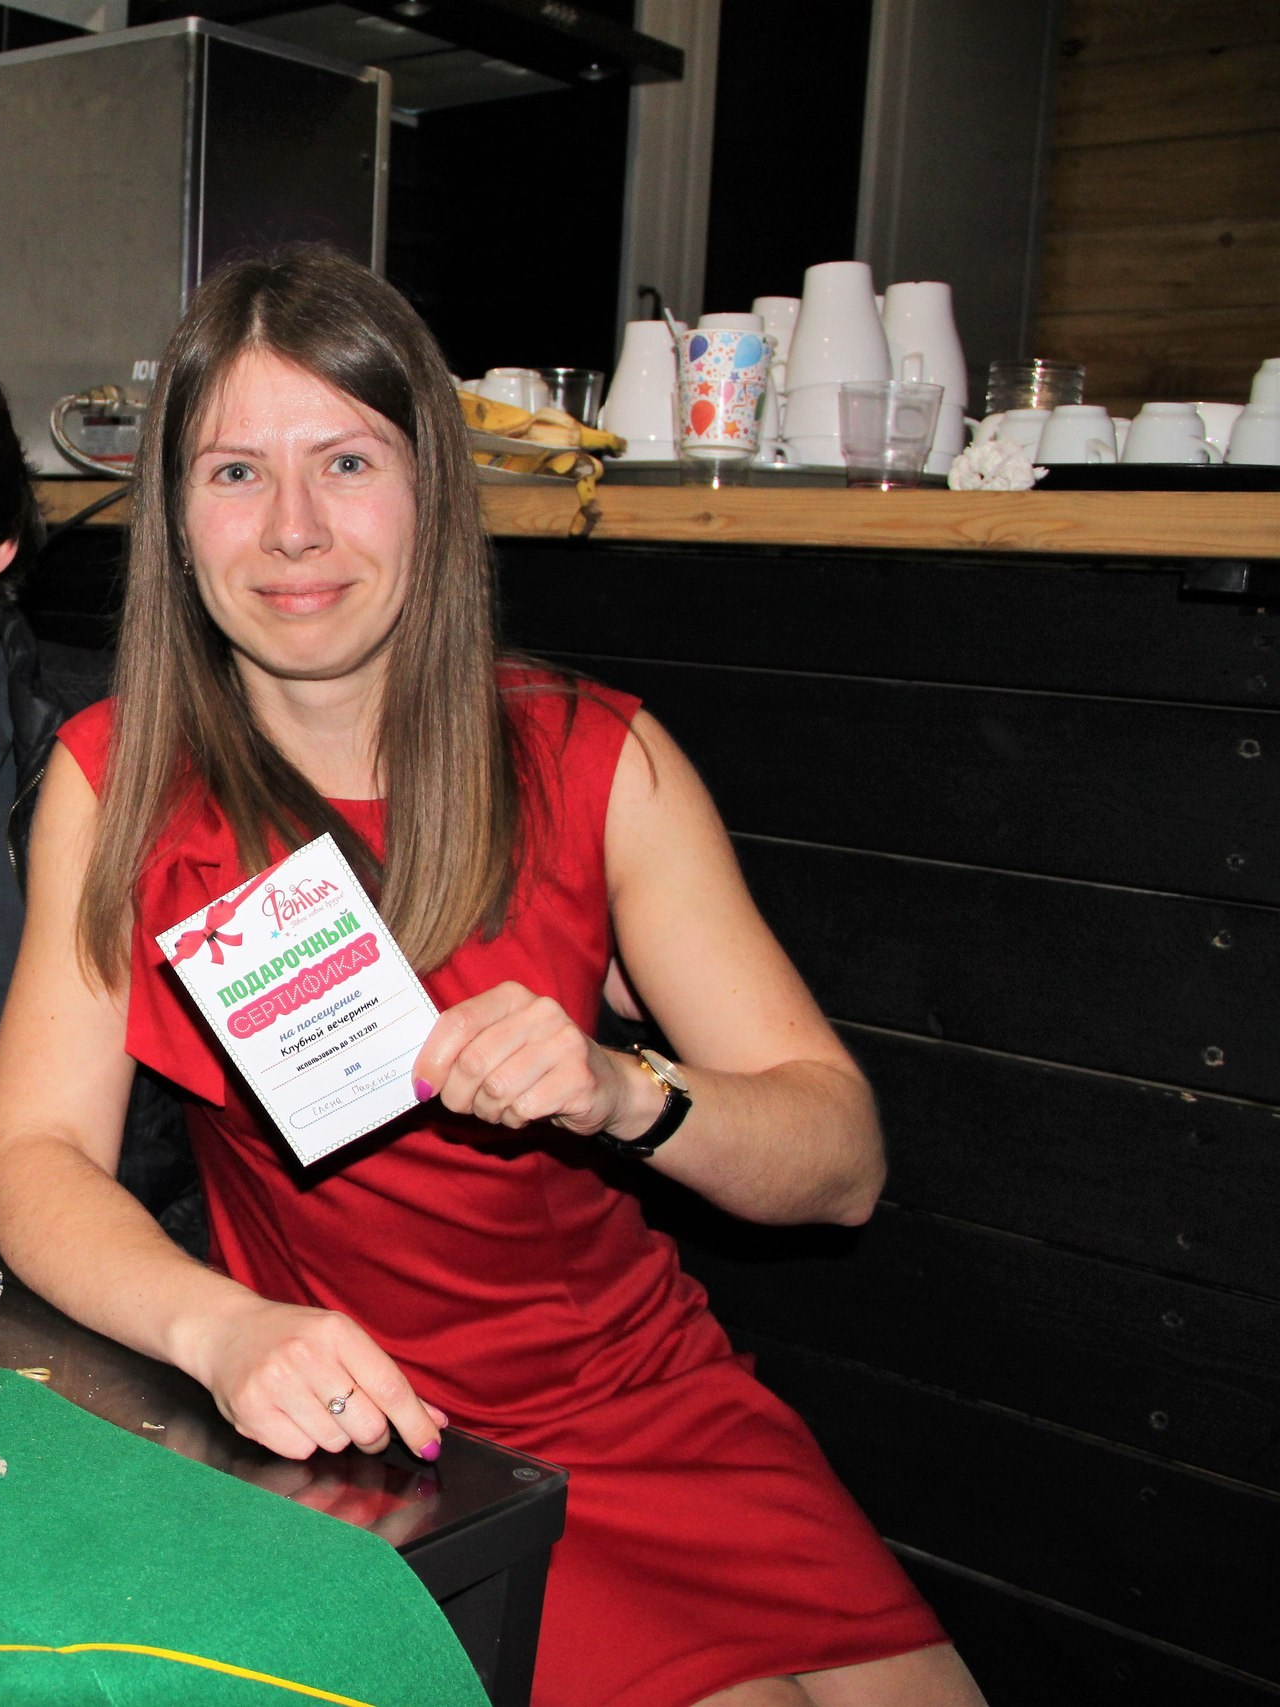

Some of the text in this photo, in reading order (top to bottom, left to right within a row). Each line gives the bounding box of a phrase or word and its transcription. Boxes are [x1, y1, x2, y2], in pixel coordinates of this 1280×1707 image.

[216, 909, 361, 1009] ПОДАРОЧНЫЙ
[234, 939, 372, 1034] СЕРТИФИКАТ
[279, 989, 363, 1042] на посещение
[280, 996, 379, 1057] Клубной вечеринки
[296, 1046, 340, 1072] использовать
[339, 1040, 349, 1049] до
[344, 1062, 362, 1077] для
